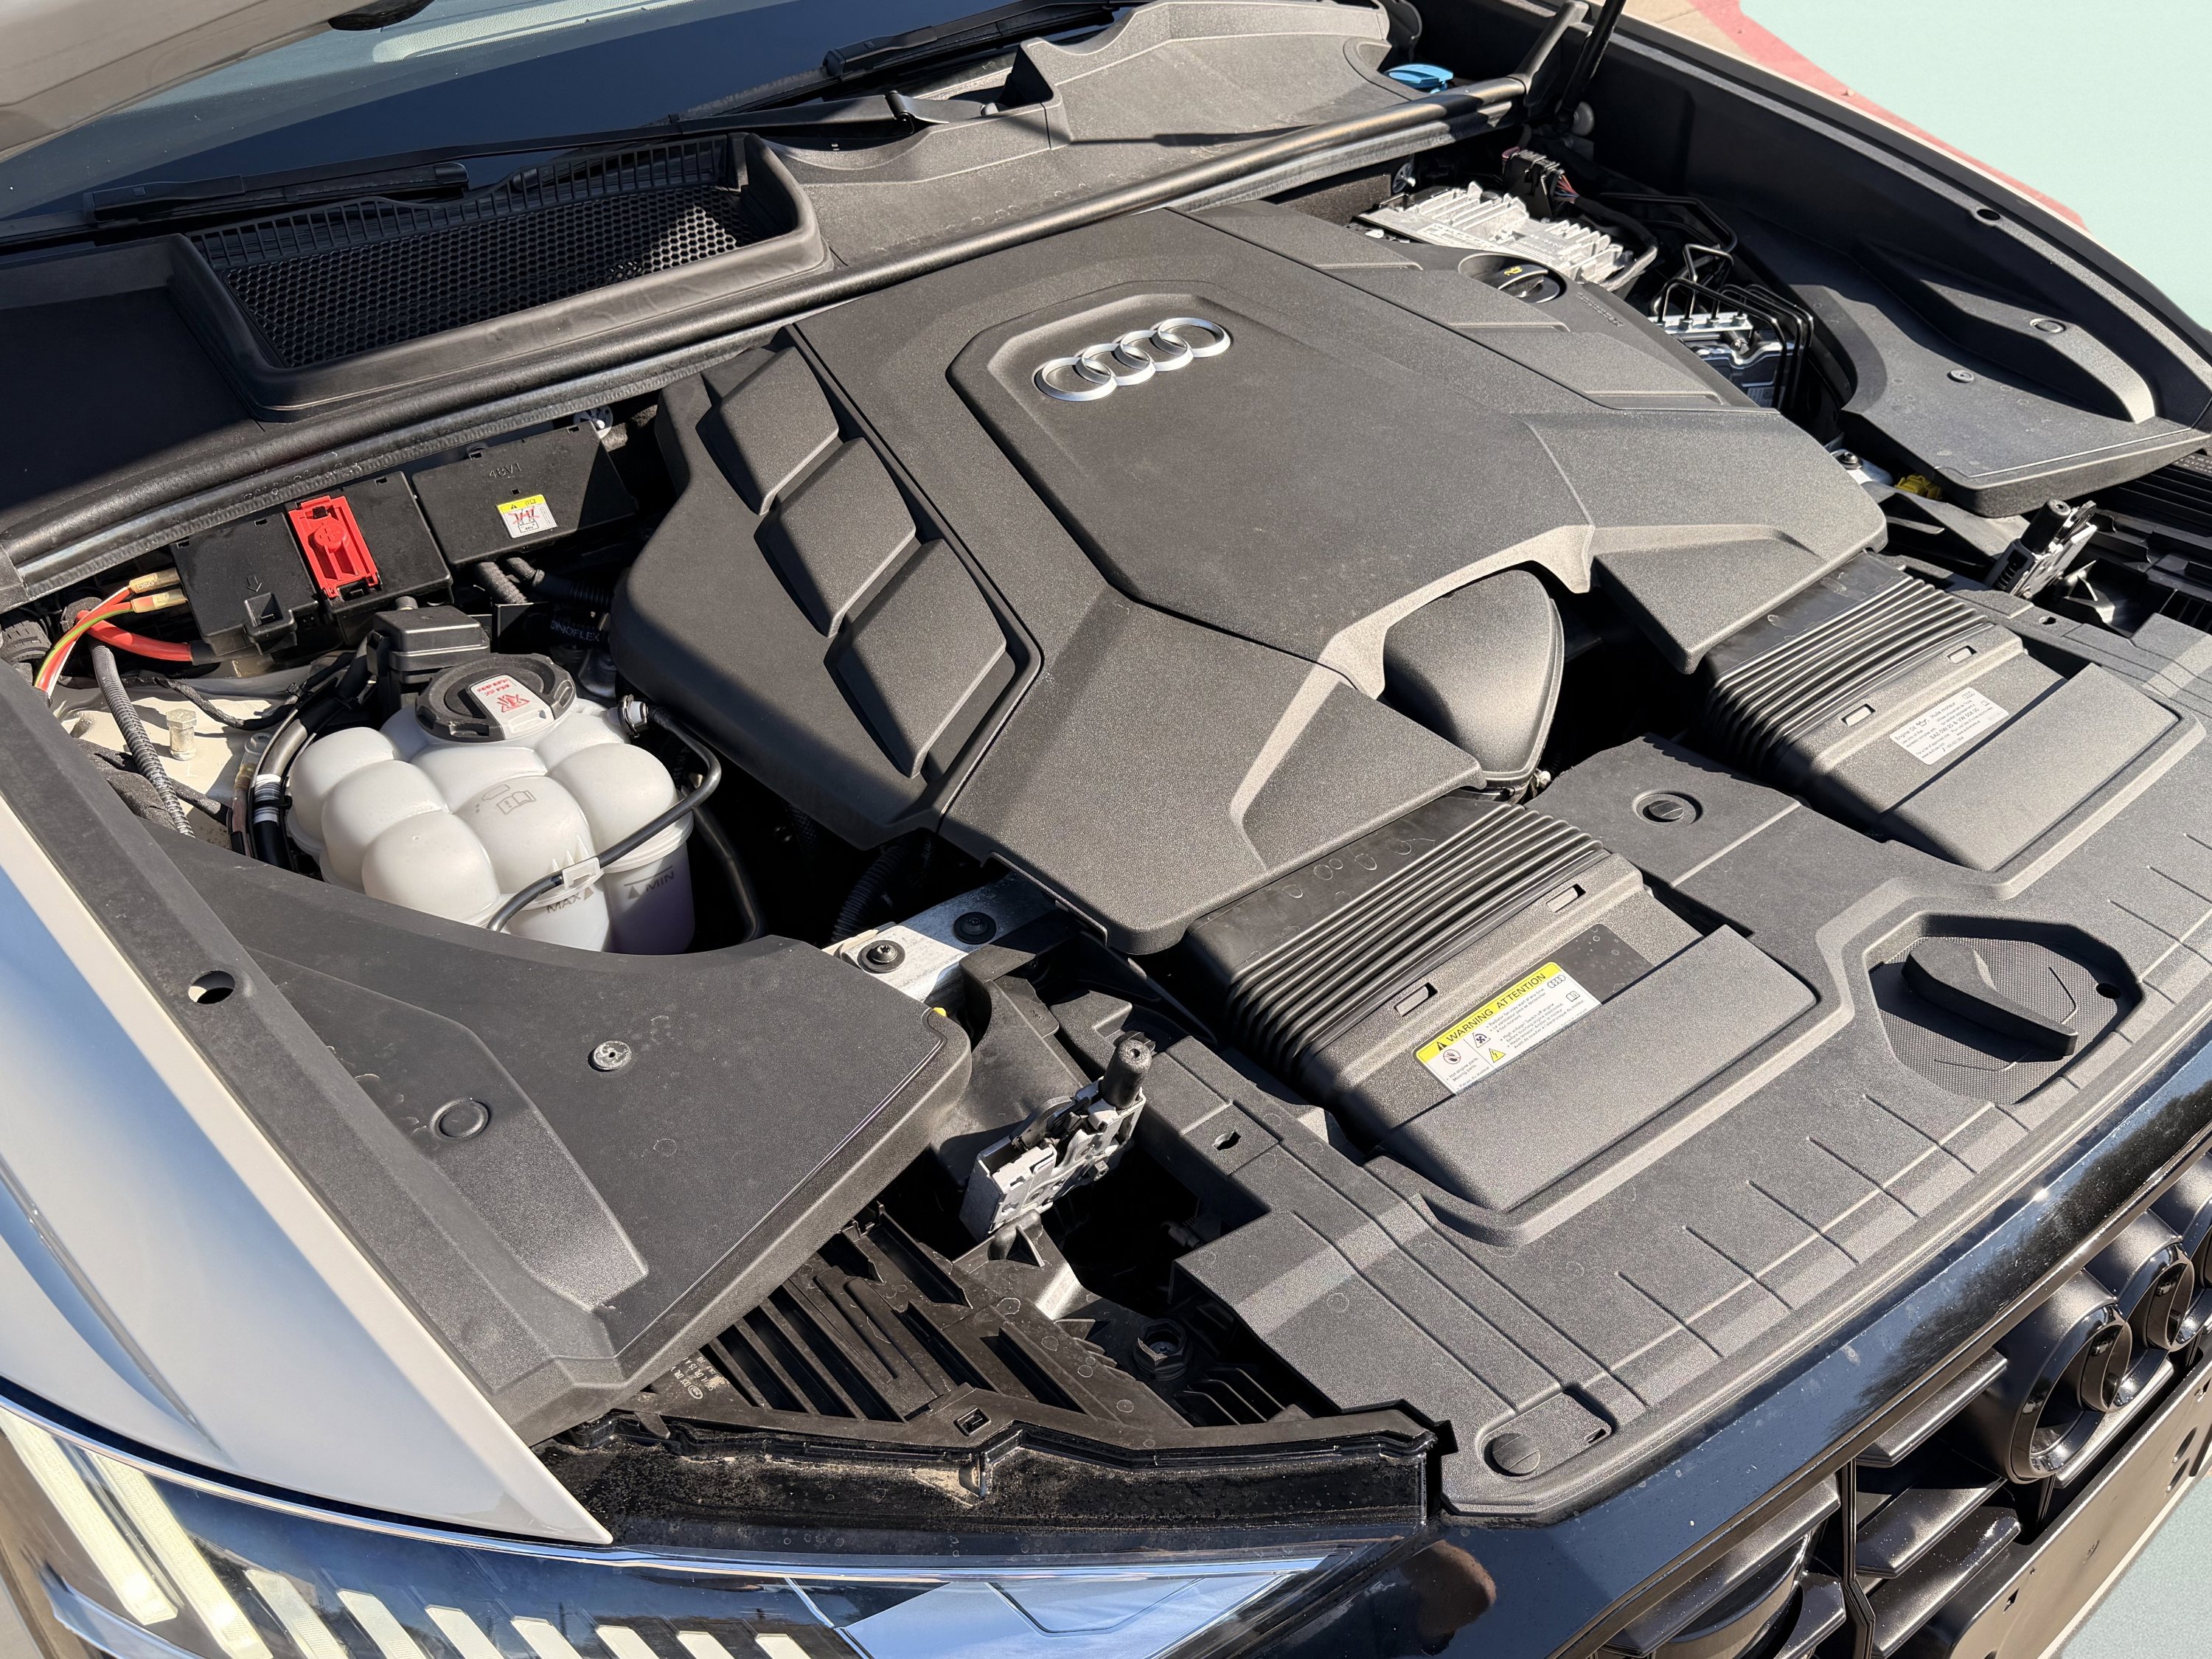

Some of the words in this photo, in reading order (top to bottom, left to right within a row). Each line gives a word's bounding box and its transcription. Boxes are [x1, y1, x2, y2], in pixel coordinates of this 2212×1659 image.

[646, 871, 675, 891] MIN
[546, 892, 581, 914] MAX
[1446, 1009, 1492, 1041] WARNING
[1497, 973, 1545, 1008] ATTENTION
